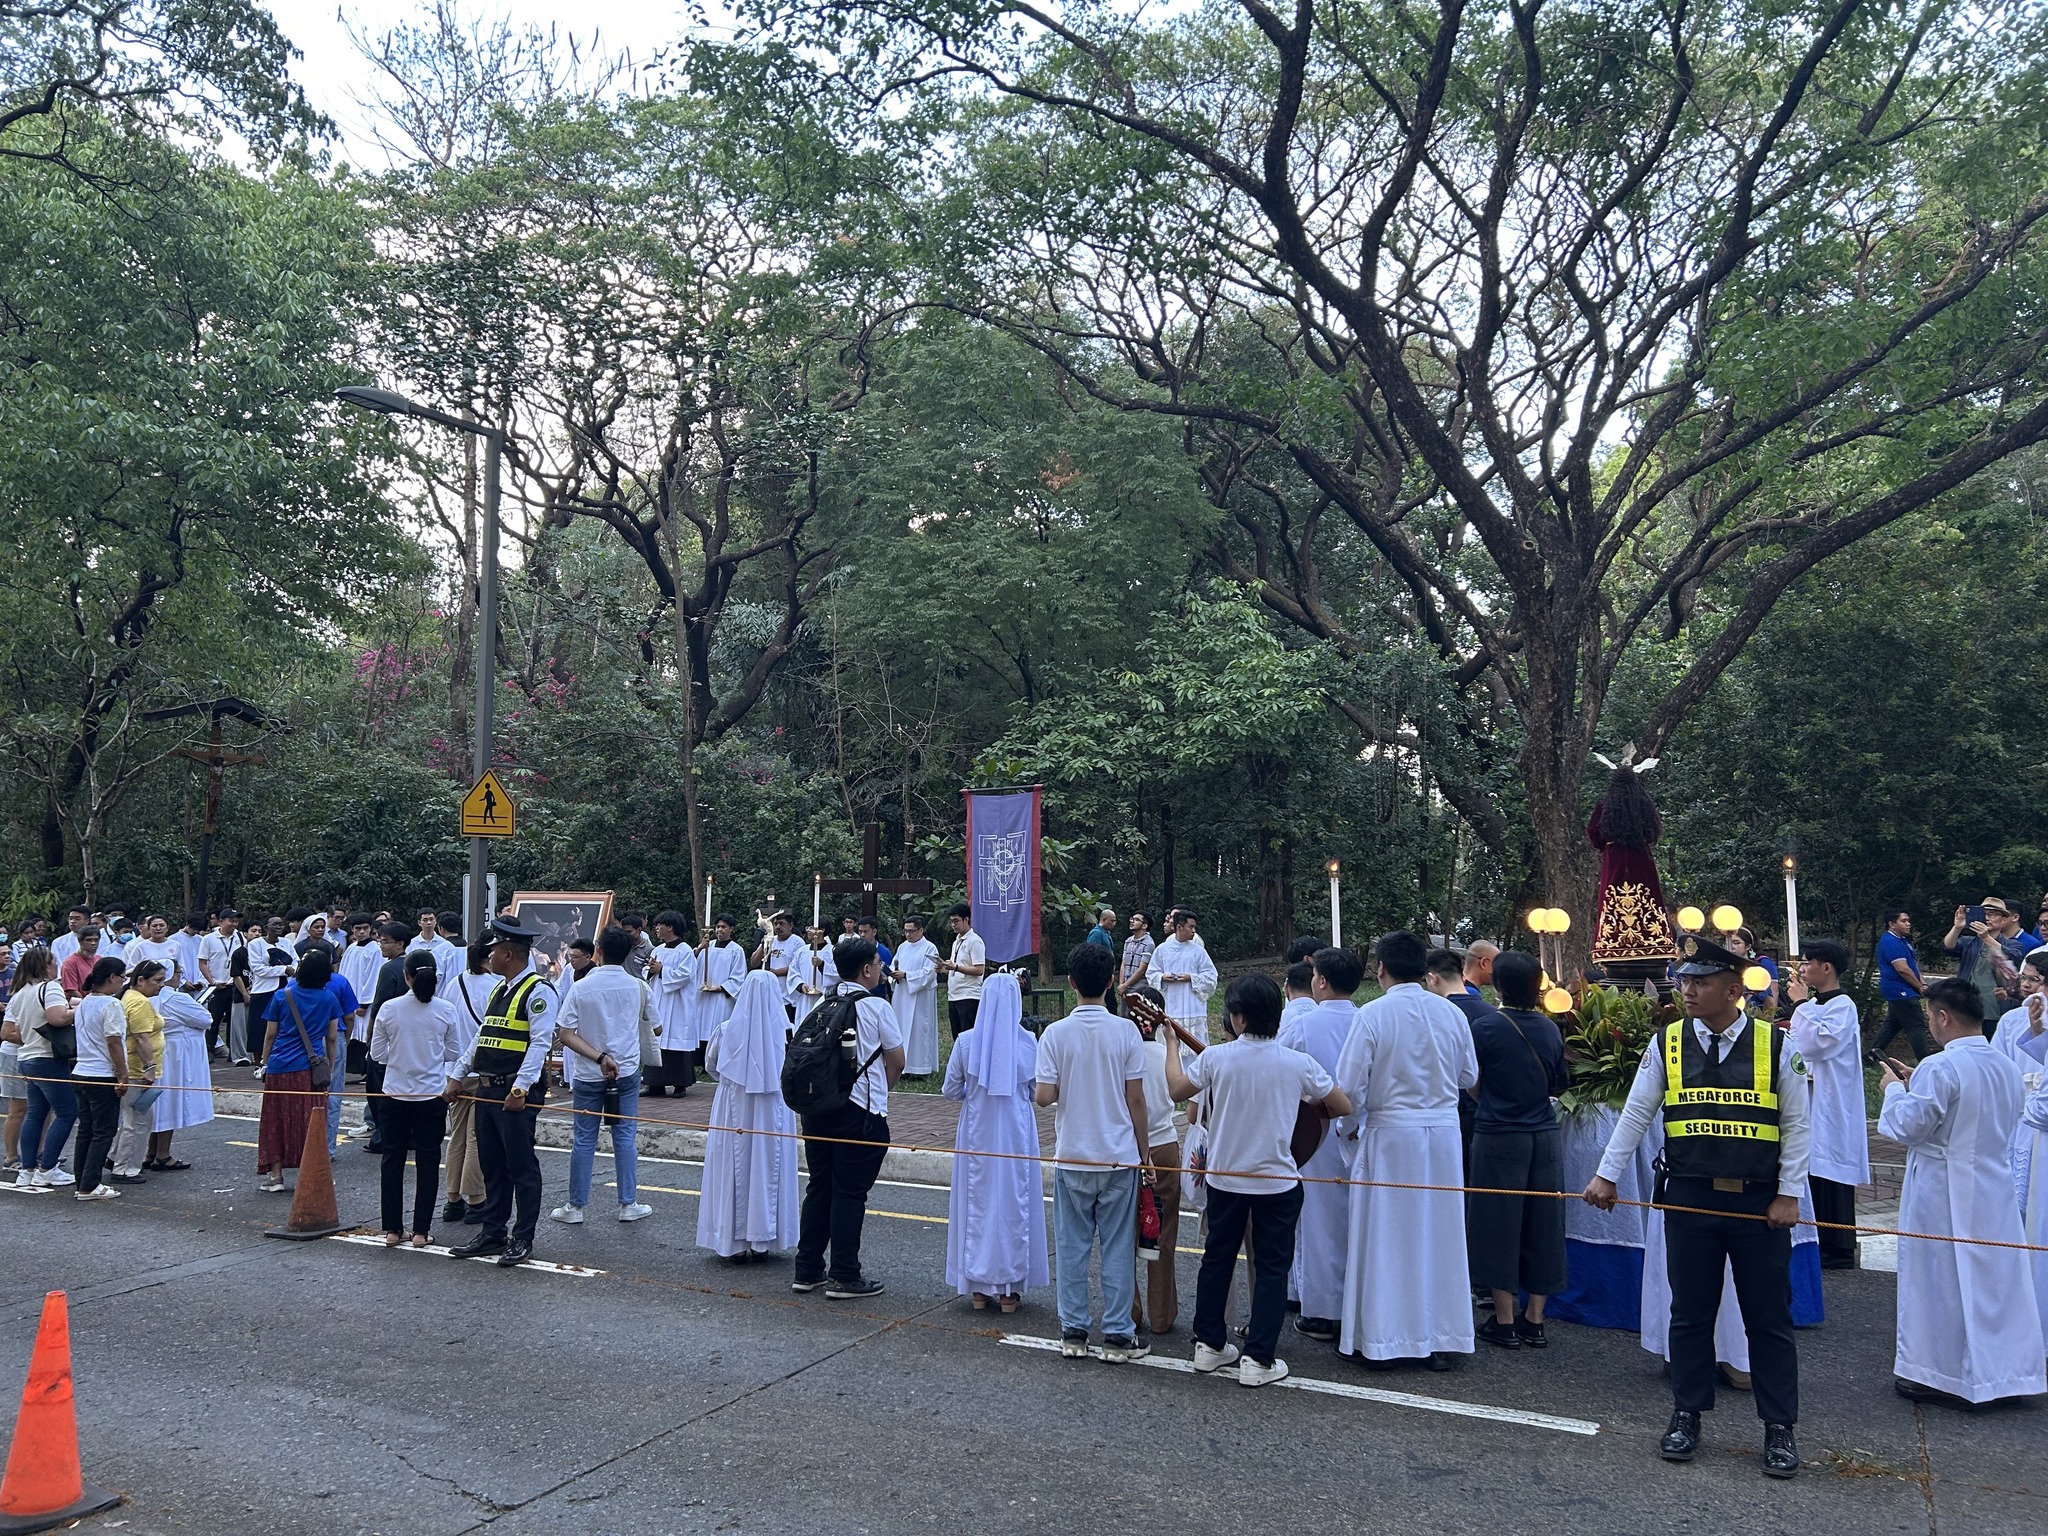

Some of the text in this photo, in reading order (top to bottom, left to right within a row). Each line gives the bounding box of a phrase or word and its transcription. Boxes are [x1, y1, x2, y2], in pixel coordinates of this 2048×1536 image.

[863, 882, 873, 891] VII
[1670, 1035, 1678, 1064] 880
[1678, 1090, 1761, 1105] MEGAFORCE
[1685, 1122, 1759, 1137] SECURITY
